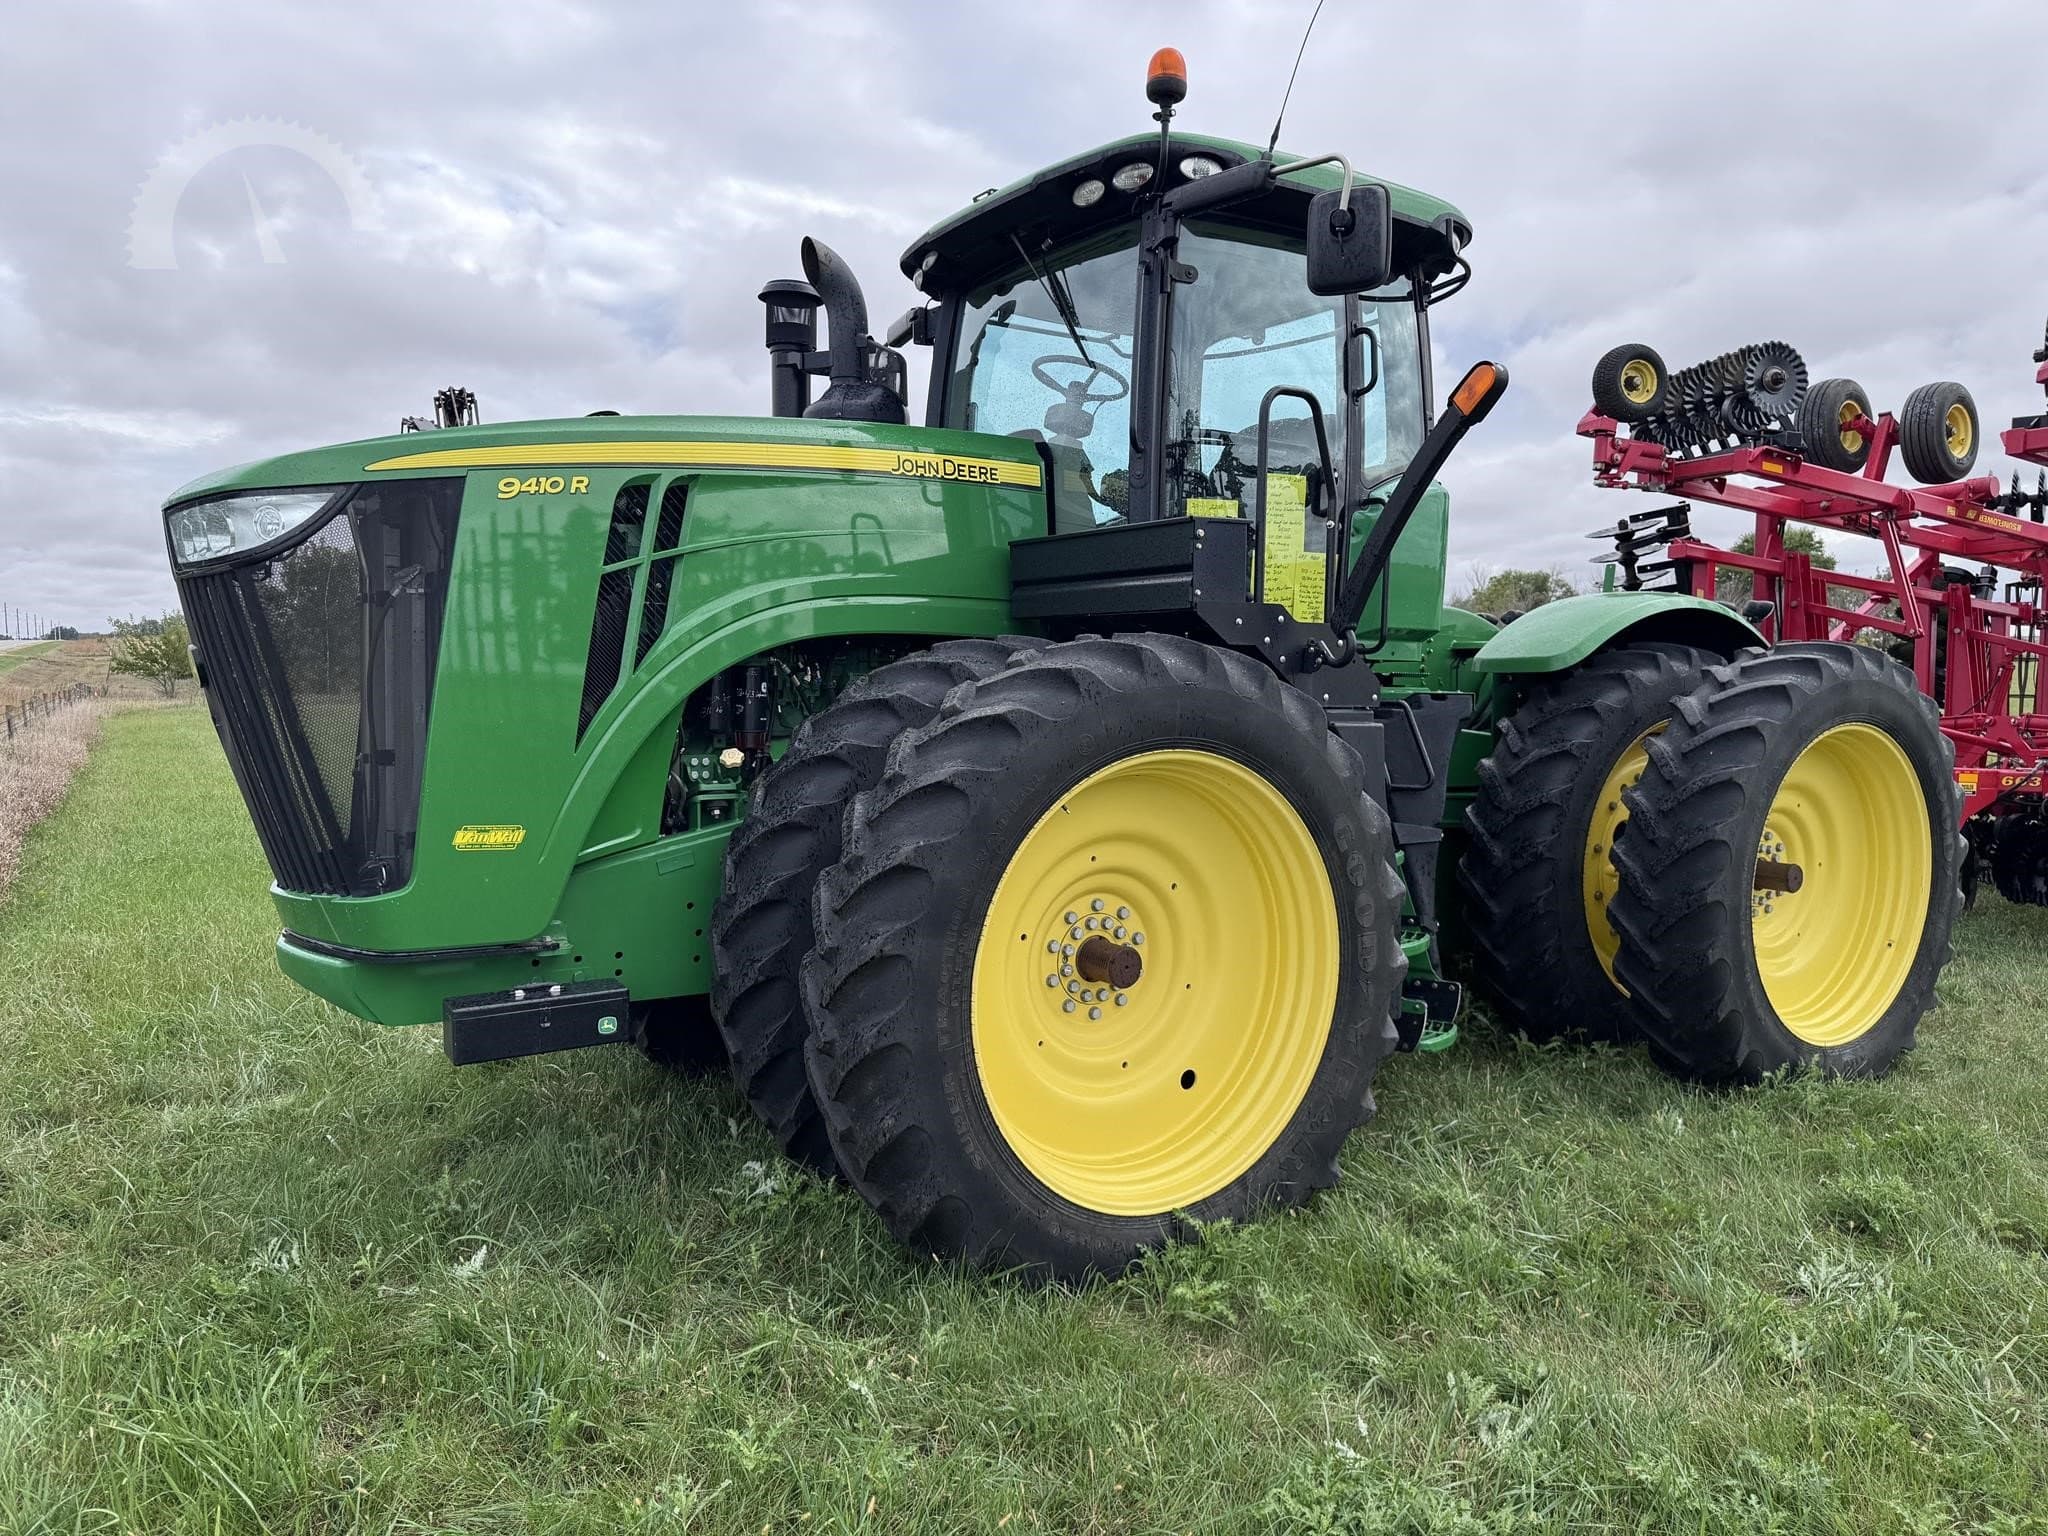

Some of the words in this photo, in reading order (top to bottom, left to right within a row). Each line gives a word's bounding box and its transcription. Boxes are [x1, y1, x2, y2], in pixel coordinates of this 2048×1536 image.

[891, 454, 940, 475] JOHN
[943, 458, 1000, 481] DEERE
[497, 476, 565, 499] 9410
[570, 475, 590, 495] R
